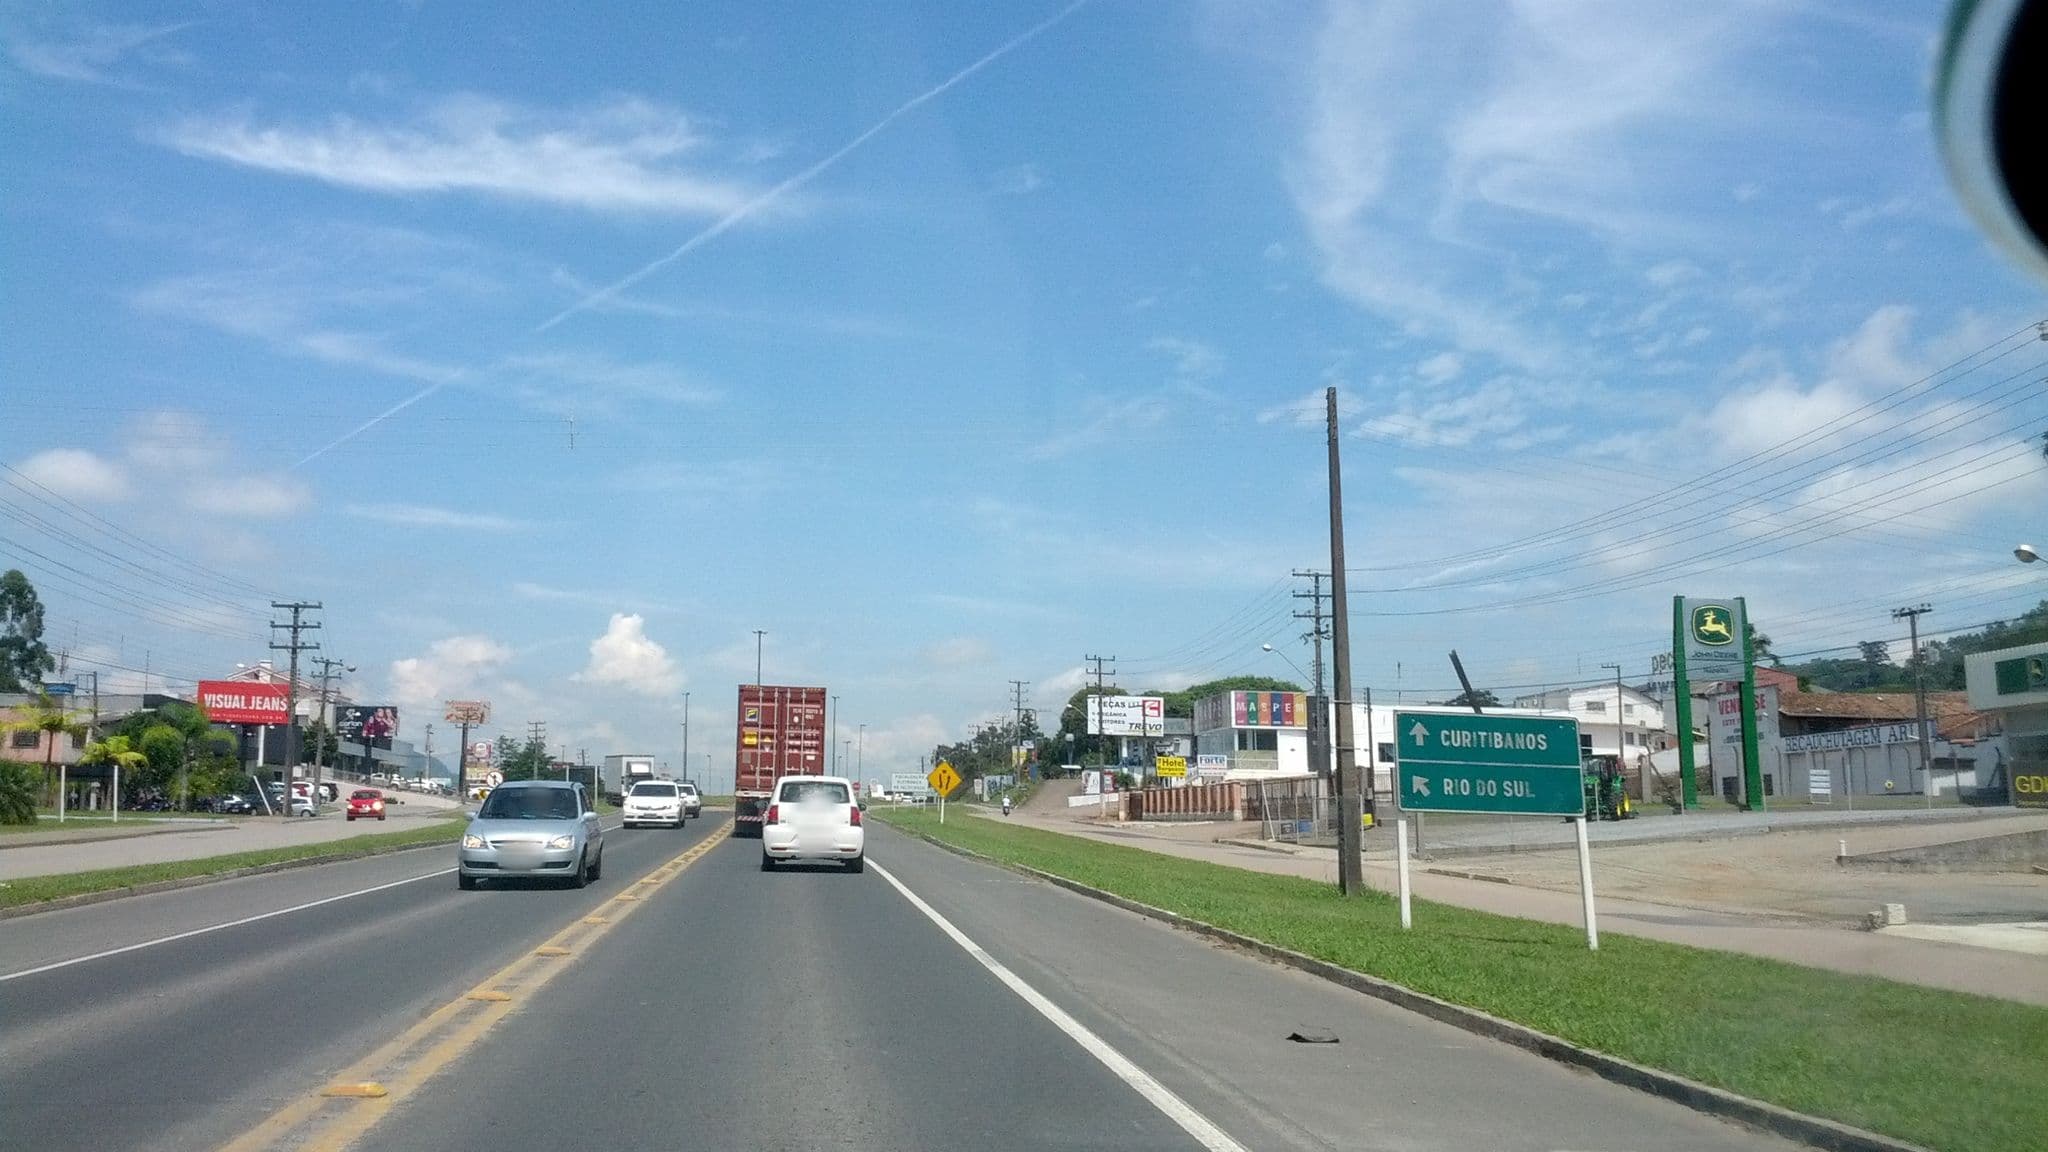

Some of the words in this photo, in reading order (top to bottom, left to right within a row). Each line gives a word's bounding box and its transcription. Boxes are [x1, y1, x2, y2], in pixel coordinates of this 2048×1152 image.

[1691, 651, 1713, 659] JOHN
[1713, 651, 1738, 659] DEERE
[204, 693, 247, 710] VISUAL
[248, 697, 287, 711] JEANS
[1236, 702, 1304, 713] MASPEM
[1440, 730, 1548, 751] CURITIBANOS
[1785, 728, 1882, 752] RECAUCHUTAGEM
[1162, 758, 1185, 767] Hotel
[1199, 756, 1225, 765] Forte
[1443, 778, 1471, 796] RIO
[1475, 780, 1499, 797] DO
[1503, 780, 1538, 798] SUL
[2015, 775, 2048, 793] GD
